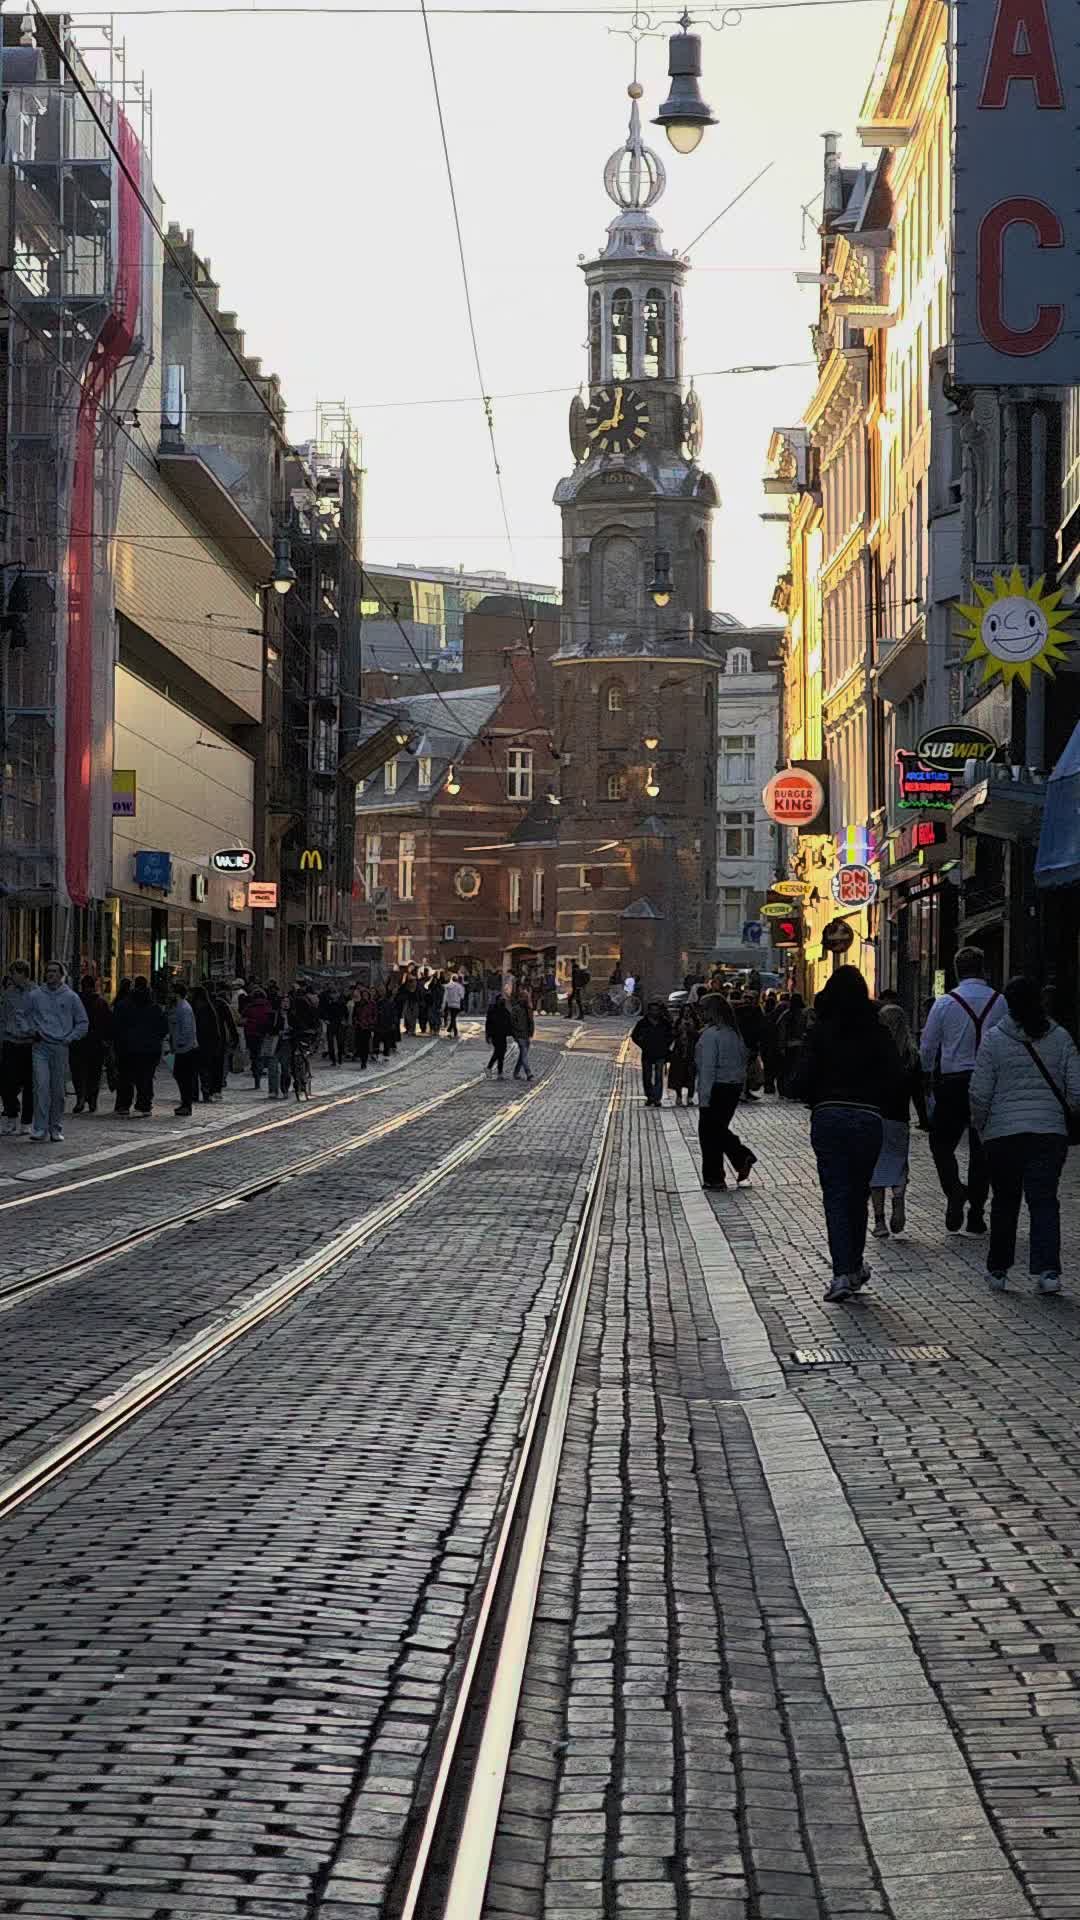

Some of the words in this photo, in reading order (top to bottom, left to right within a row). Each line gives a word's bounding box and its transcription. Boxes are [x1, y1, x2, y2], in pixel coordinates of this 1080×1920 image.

[919, 742, 996, 758] SUBWAY
[774, 790, 813, 798] BURGER
[774, 799, 813, 811] KING
